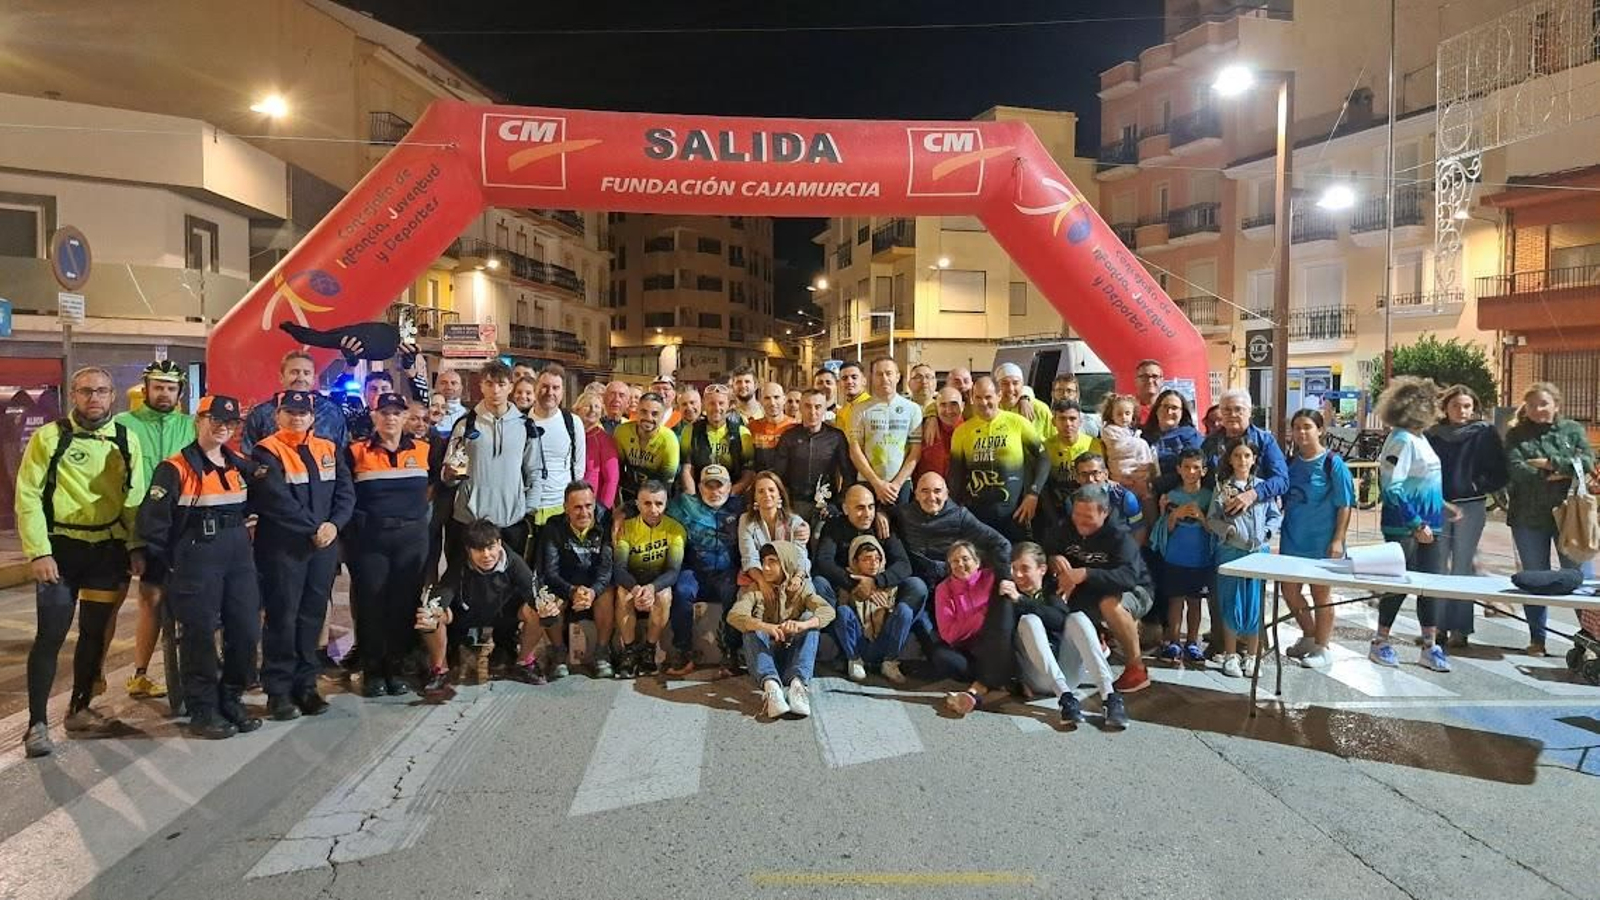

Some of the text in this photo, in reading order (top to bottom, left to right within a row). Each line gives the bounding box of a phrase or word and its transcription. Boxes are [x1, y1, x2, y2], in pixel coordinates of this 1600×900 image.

[498, 119, 558, 143] CM
[645, 127, 843, 163] SALIDA
[923, 132, 974, 152] CM
[388, 163, 440, 219] Juventud
[601, 176, 881, 197] FUNDACIÓN CAJAMURCIA
[375, 197, 439, 263] y Deportes
[1091, 276, 1148, 334] y Deportes
[1132, 292, 1177, 338] Juventud
[973, 434, 1008, 449] ALBOX
